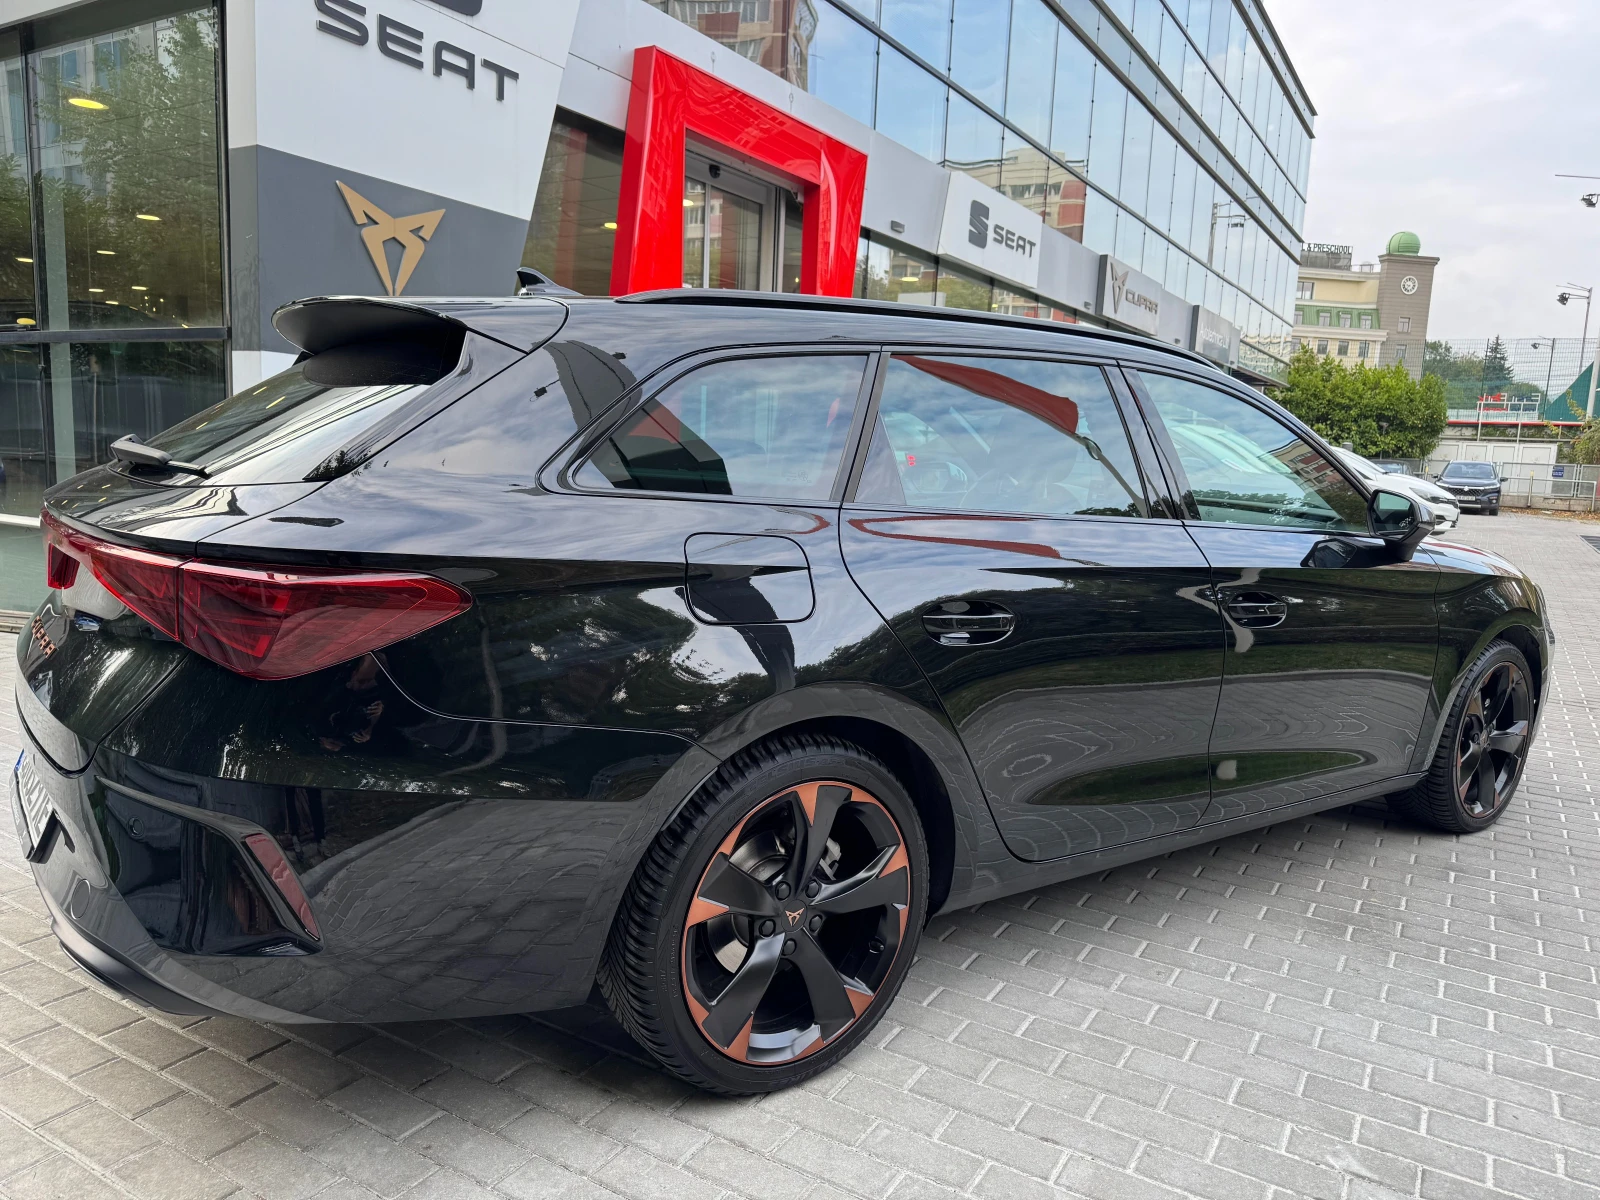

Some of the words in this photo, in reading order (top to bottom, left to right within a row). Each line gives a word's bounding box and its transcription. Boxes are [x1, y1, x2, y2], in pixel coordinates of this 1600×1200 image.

[315, 0, 519, 101] SEAT
[992, 223, 1037, 258] SEAT
[1313, 243, 1353, 254] PRESCHOOL
[1125, 288, 1159, 315] CUPRA
